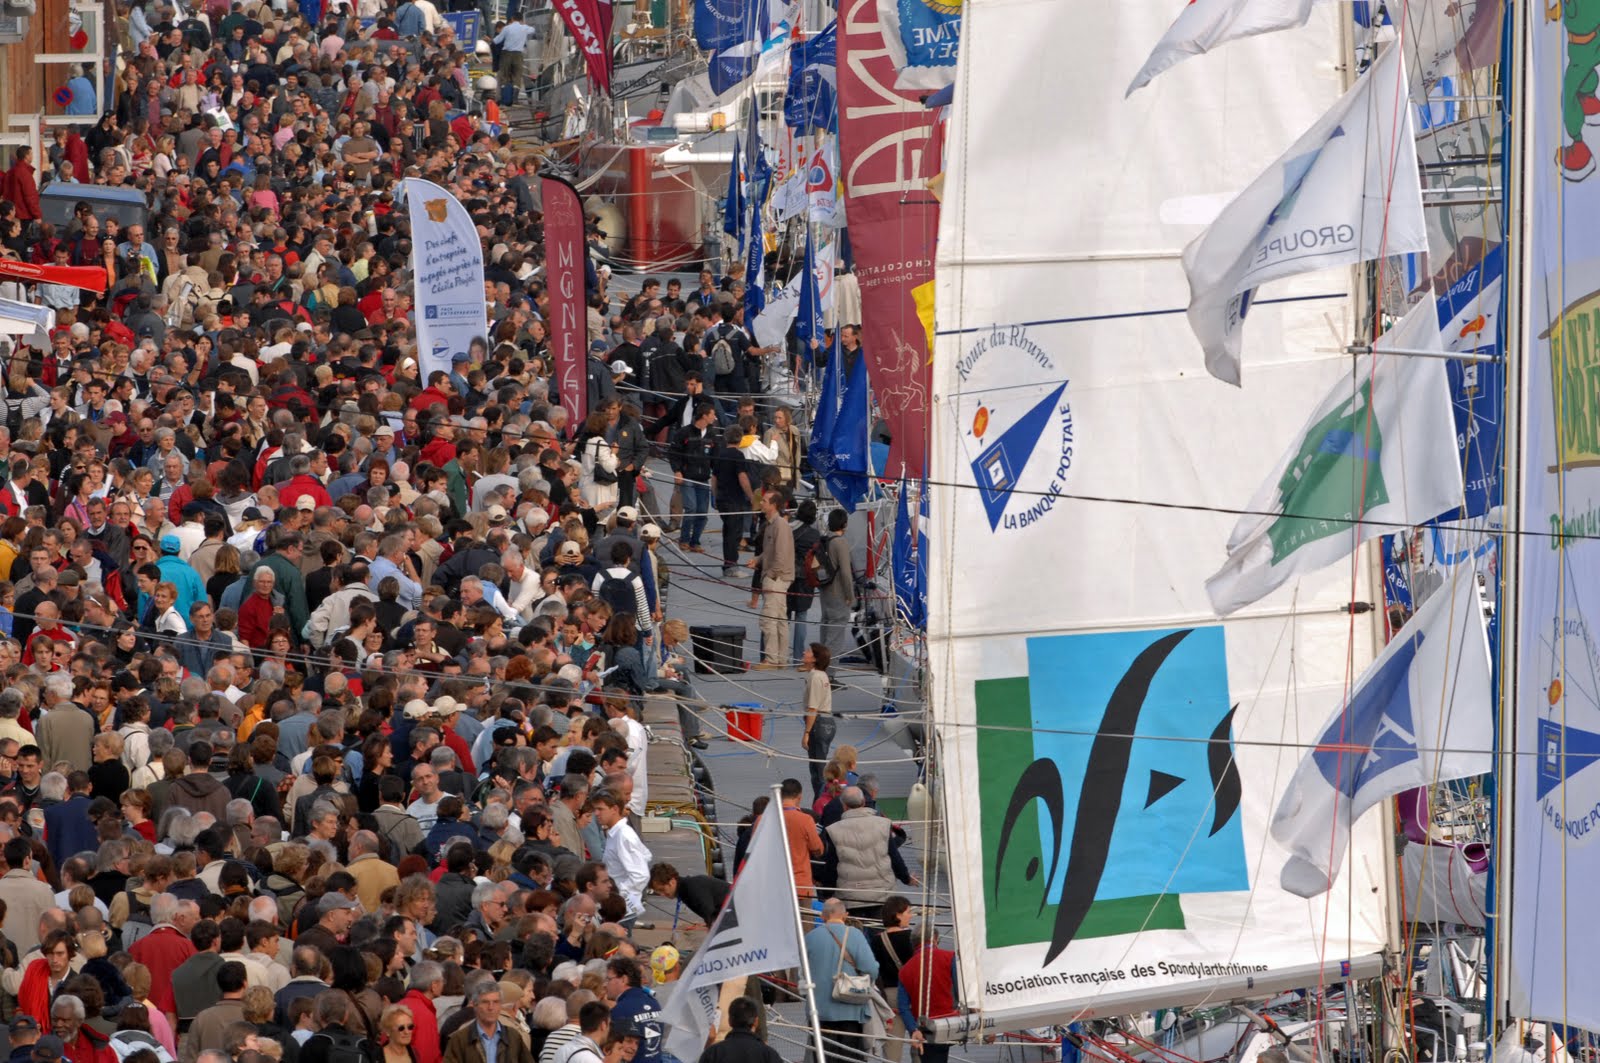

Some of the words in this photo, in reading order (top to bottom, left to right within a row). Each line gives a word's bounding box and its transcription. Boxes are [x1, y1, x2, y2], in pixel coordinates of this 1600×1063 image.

[956, 338, 987, 382] Route
[990, 323, 1005, 348] du
[1004, 514, 1017, 530] LA
[1019, 480, 1062, 528] BANQUE
[1056, 403, 1074, 481] POSTALE
[985, 974, 1061, 996] Association
[1061, 969, 1126, 986] Française
[1130, 962, 1156, 979] des
